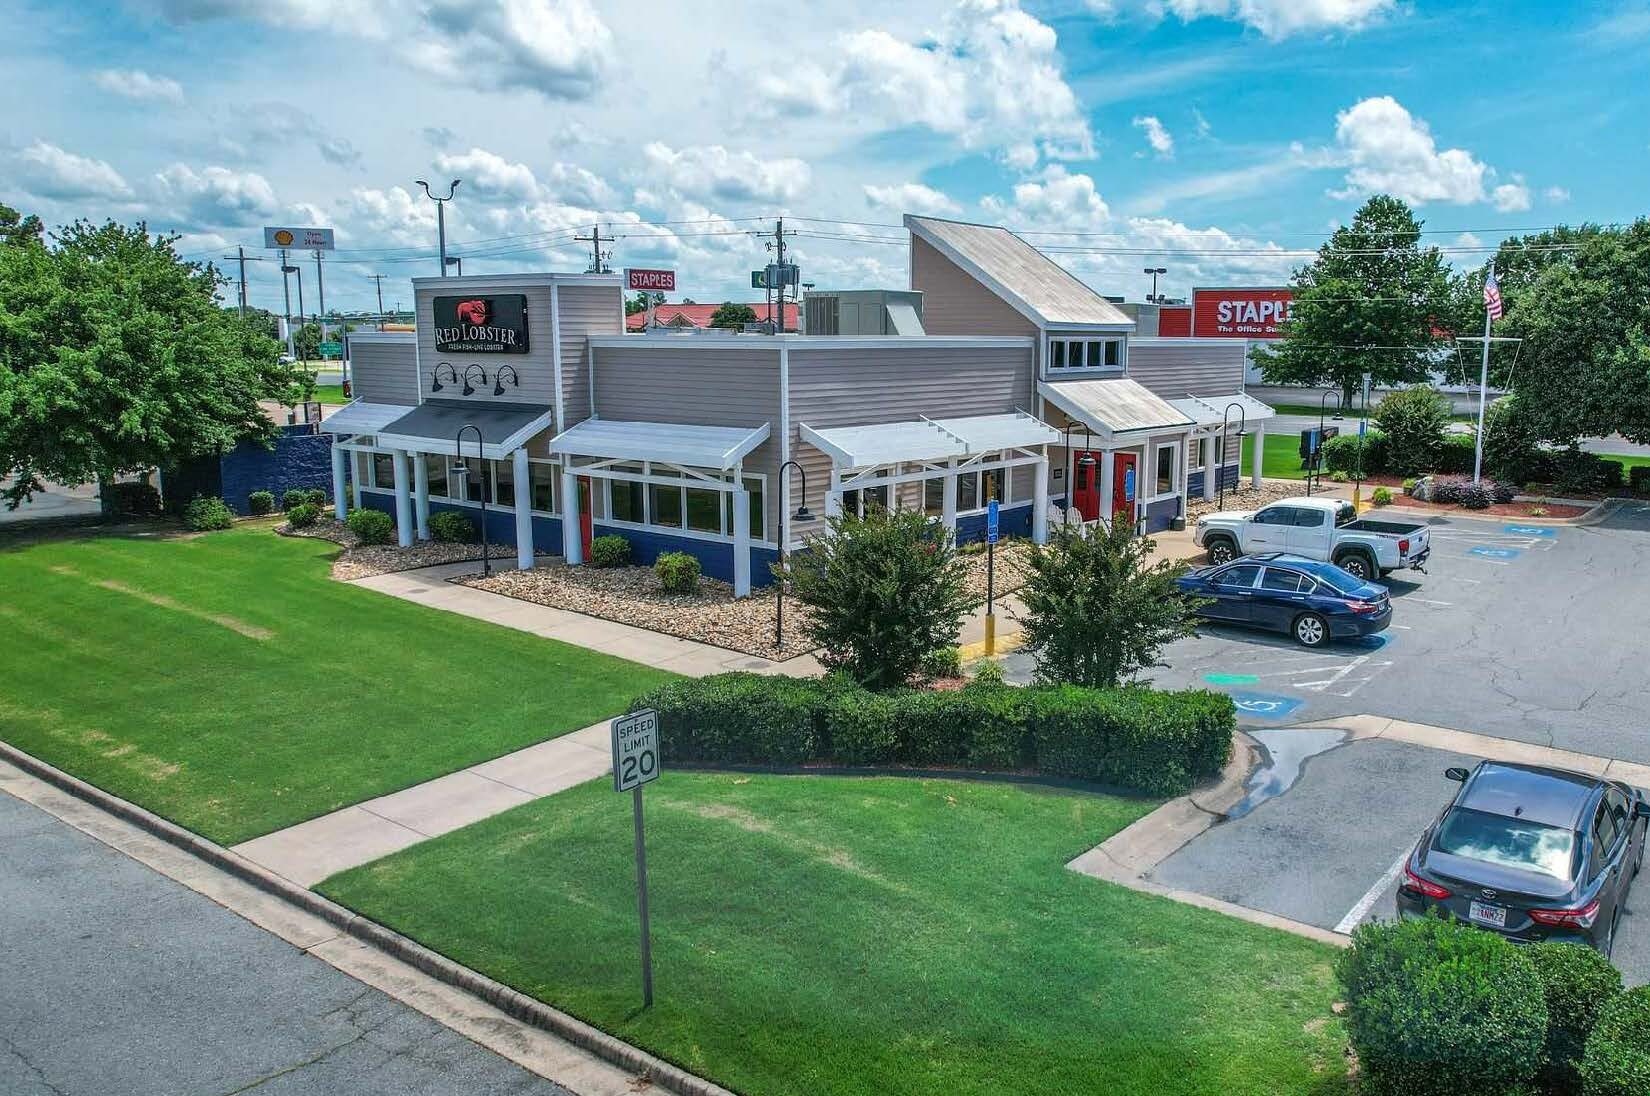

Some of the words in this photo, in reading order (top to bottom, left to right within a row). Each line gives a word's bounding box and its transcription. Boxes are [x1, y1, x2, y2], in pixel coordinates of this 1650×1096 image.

[631, 273, 673, 287] STAPLES
[435, 327, 460, 346] RED
[462, 323, 516, 346] LOBSTER
[1218, 325, 1233, 333] The
[1237, 325, 1262, 333] Office
[620, 719, 653, 739] SPEED
[624, 734, 650, 753] LIMIT
[622, 750, 655, 785] 20
